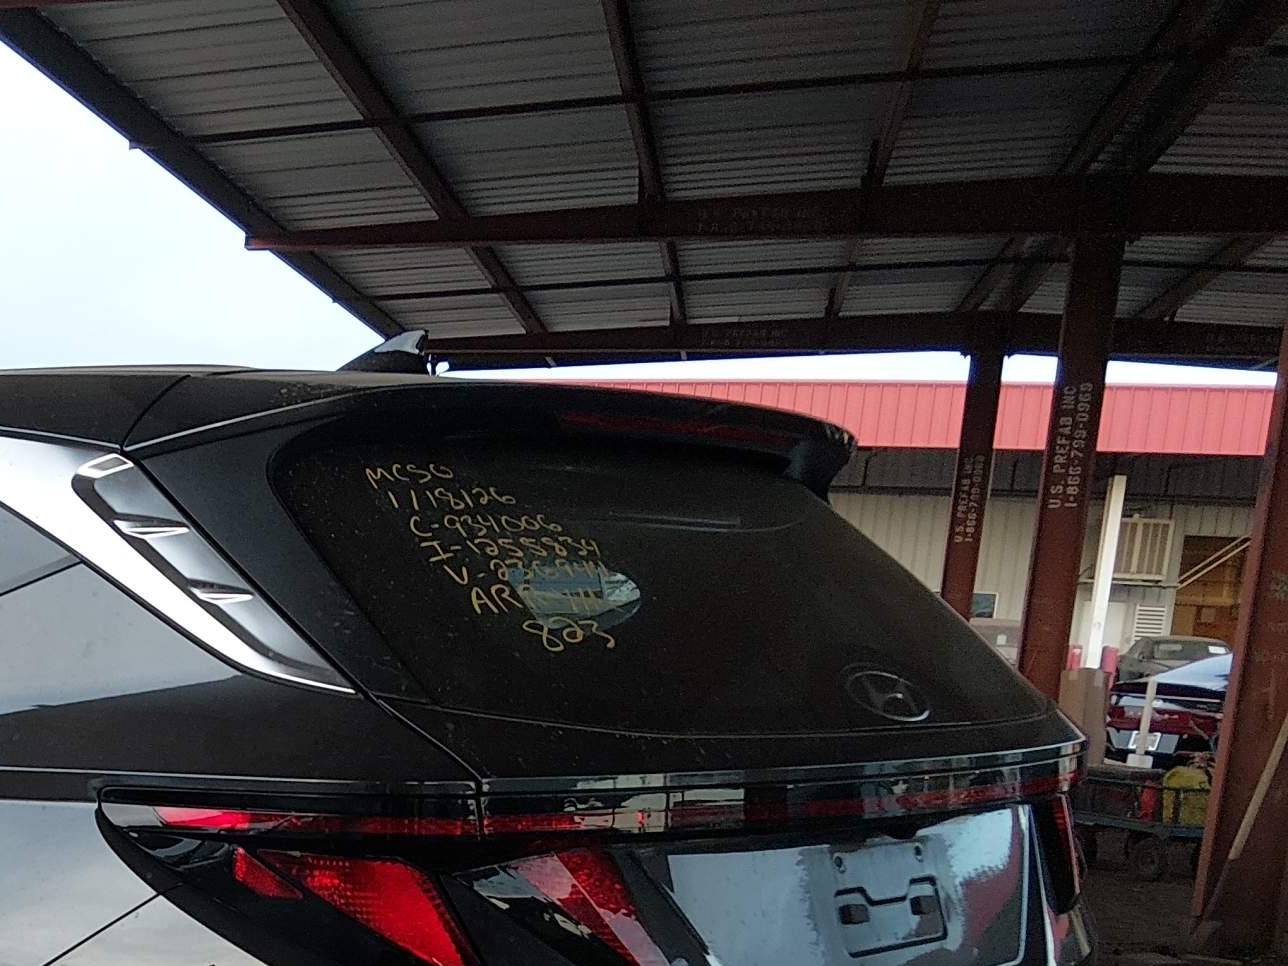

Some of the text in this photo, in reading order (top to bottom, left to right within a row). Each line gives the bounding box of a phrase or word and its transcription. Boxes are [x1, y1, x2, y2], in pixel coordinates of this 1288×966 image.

[1047, 385, 1078, 509] U.S. PREFAB INC
[956, 478, 972, 518] PREFAB
